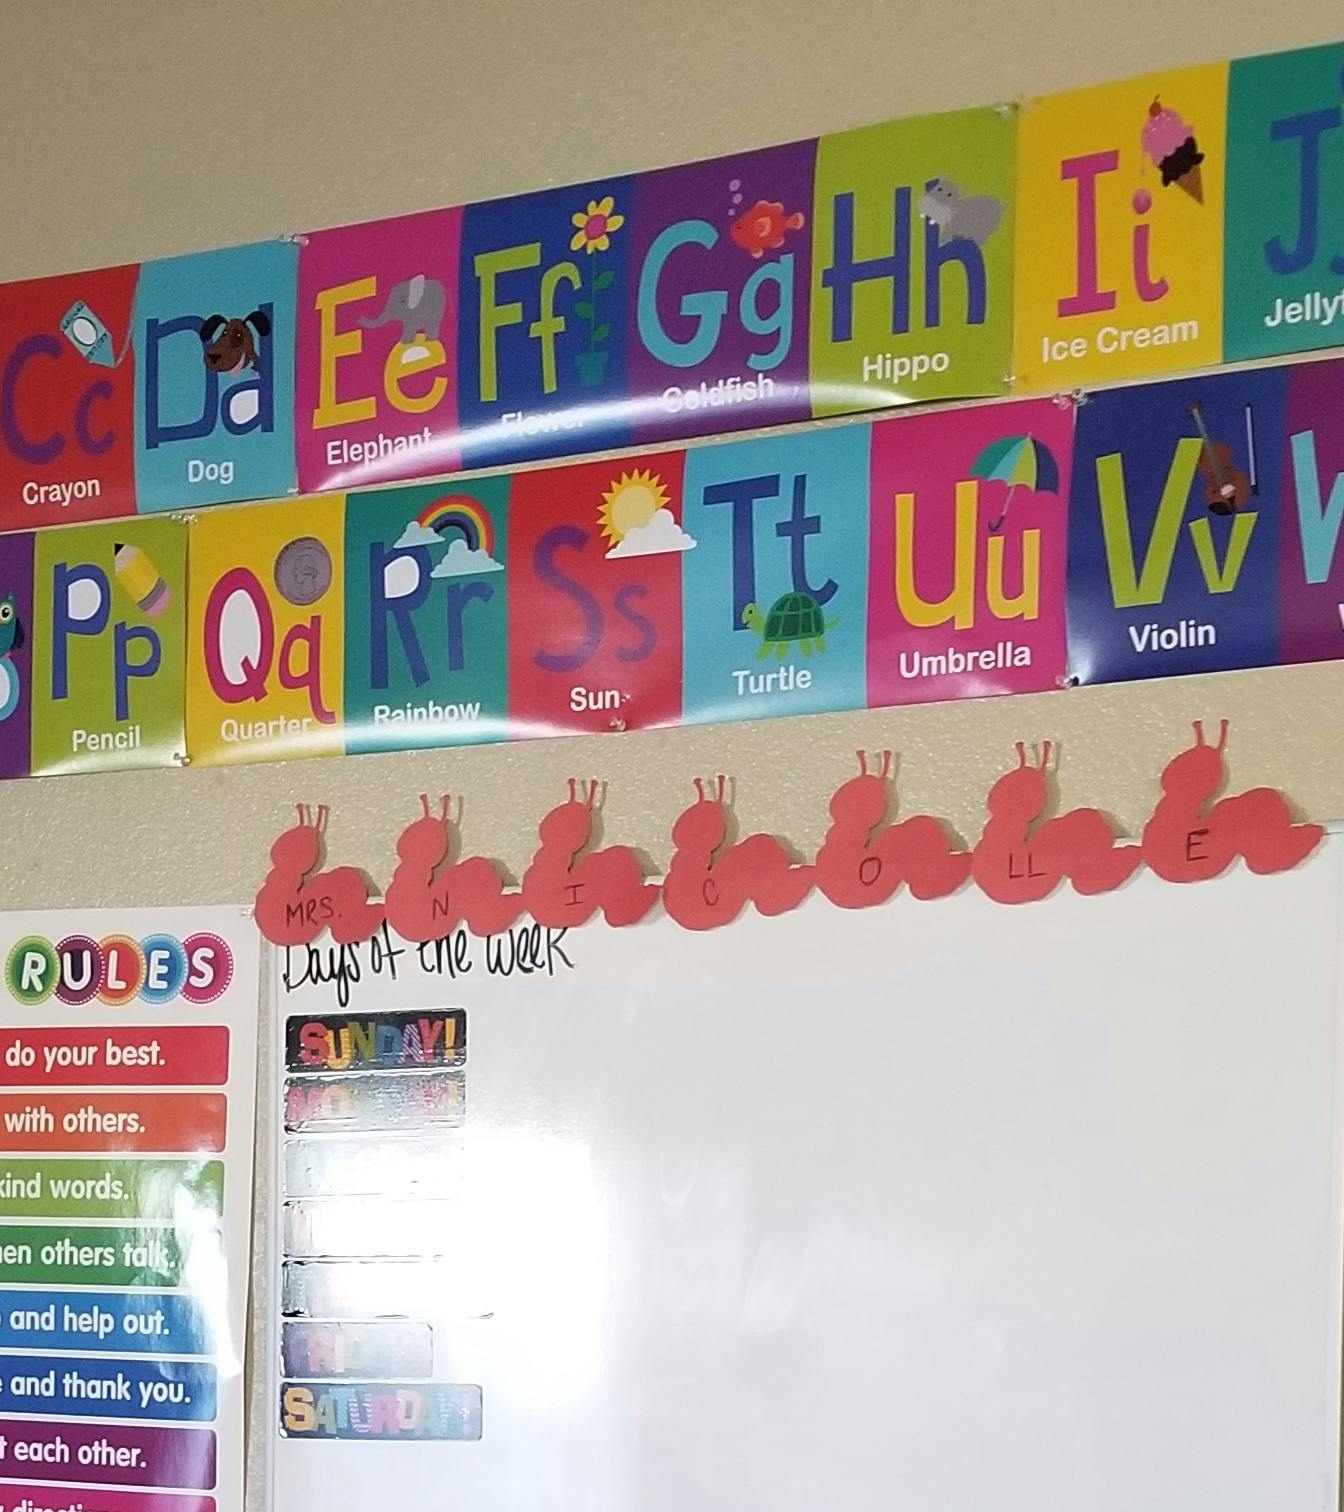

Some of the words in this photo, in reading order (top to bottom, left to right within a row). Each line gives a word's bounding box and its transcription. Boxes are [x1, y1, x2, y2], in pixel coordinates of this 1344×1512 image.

[1057, 150, 1168, 318] Ii
[637, 219, 795, 370] Gg
[1042, 335, 1086, 361] Ice
[1097, 318, 1198, 354] Cream
[862, 350, 950, 382] Hippo
[326, 428, 432, 465] Elephant
[188, 459, 234, 485] Dog
[22, 478, 100, 506] Crayon
[895, 480, 1038, 629] Uu
[1129, 621, 1215, 652] Violin
[899, 642, 1031, 679] Umbrella
[732, 667, 812, 697] Turtle
[373, 699, 480, 726] Rainbow
[570, 686, 620, 711] Sun
[72, 727, 141, 752] Pencil
[220, 716, 312, 742] Quarter
[20, 947, 216, 992] RULES
[6, 1040, 35, 1066] do
[44, 1043, 98, 1072] your
[105, 1038, 165, 1066] best.
[4, 1106, 54, 1132] with
[63, 1106, 145, 1132] others.
[50, 1174, 129, 1199] words.
[41, 1241, 114, 1266] others
[64, 1306, 113, 1339] help
[123, 1310, 169, 1335] out.
[63, 1373, 131, 1400] thank
[140, 1382, 190, 1407] you.
[15, 1437, 69, 1463] each
[78, 1439, 146, 1468] other.
